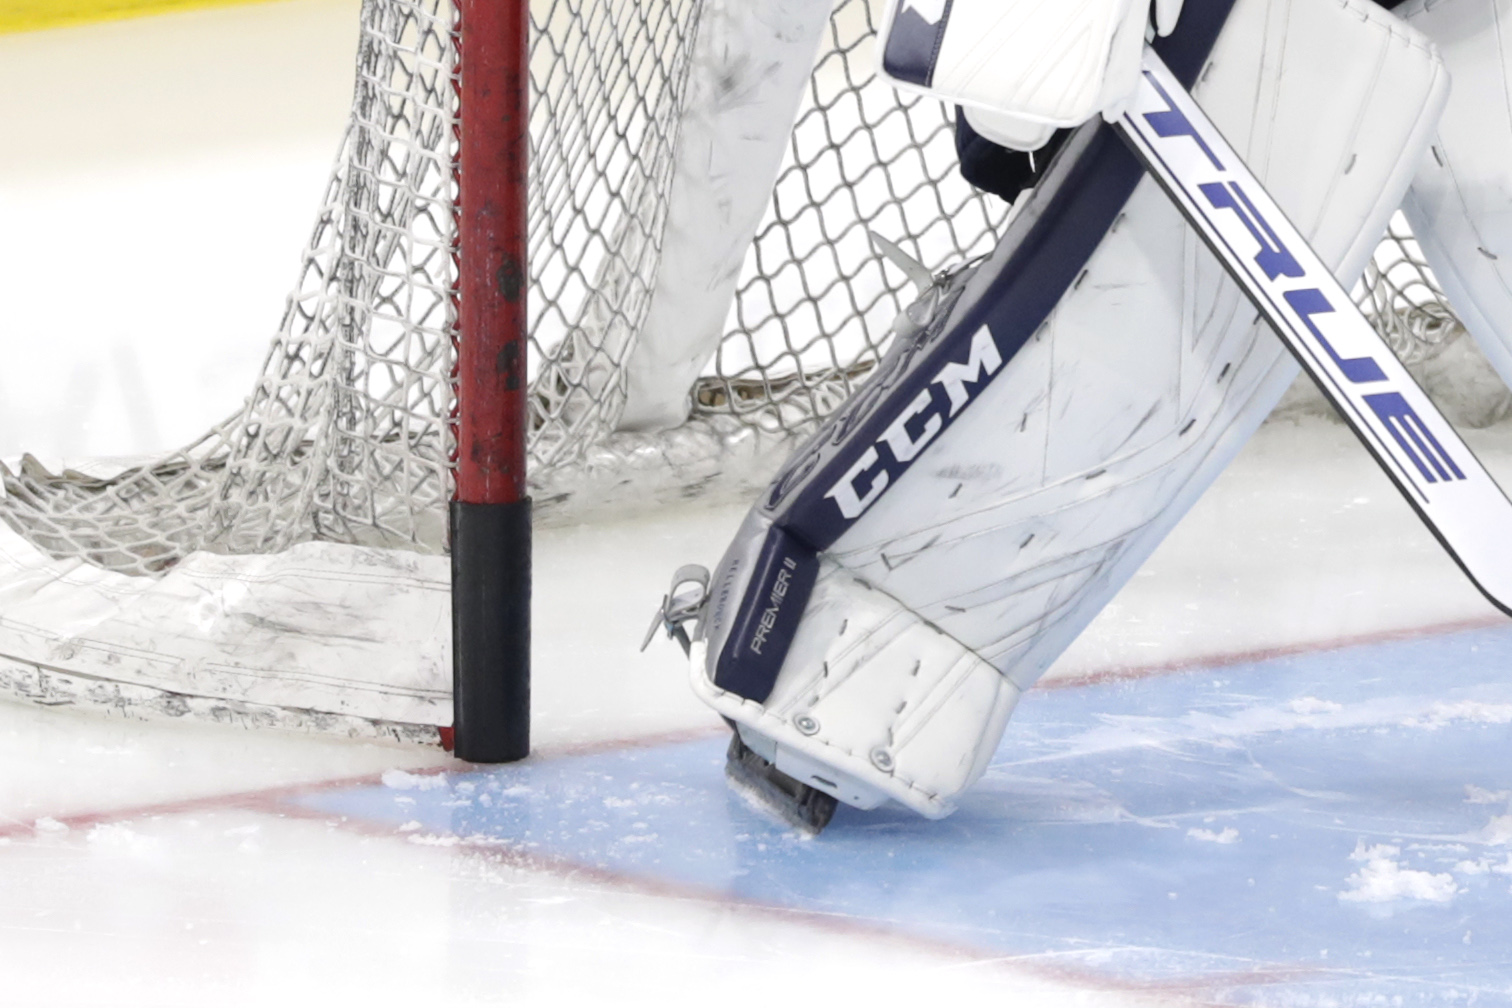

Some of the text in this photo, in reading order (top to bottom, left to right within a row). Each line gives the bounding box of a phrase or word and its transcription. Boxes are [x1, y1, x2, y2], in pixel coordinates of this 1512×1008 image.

[1142, 69, 1467, 485] TRUE
[823, 323, 1004, 520] CCM
[750, 568, 792, 655] PREMIER
